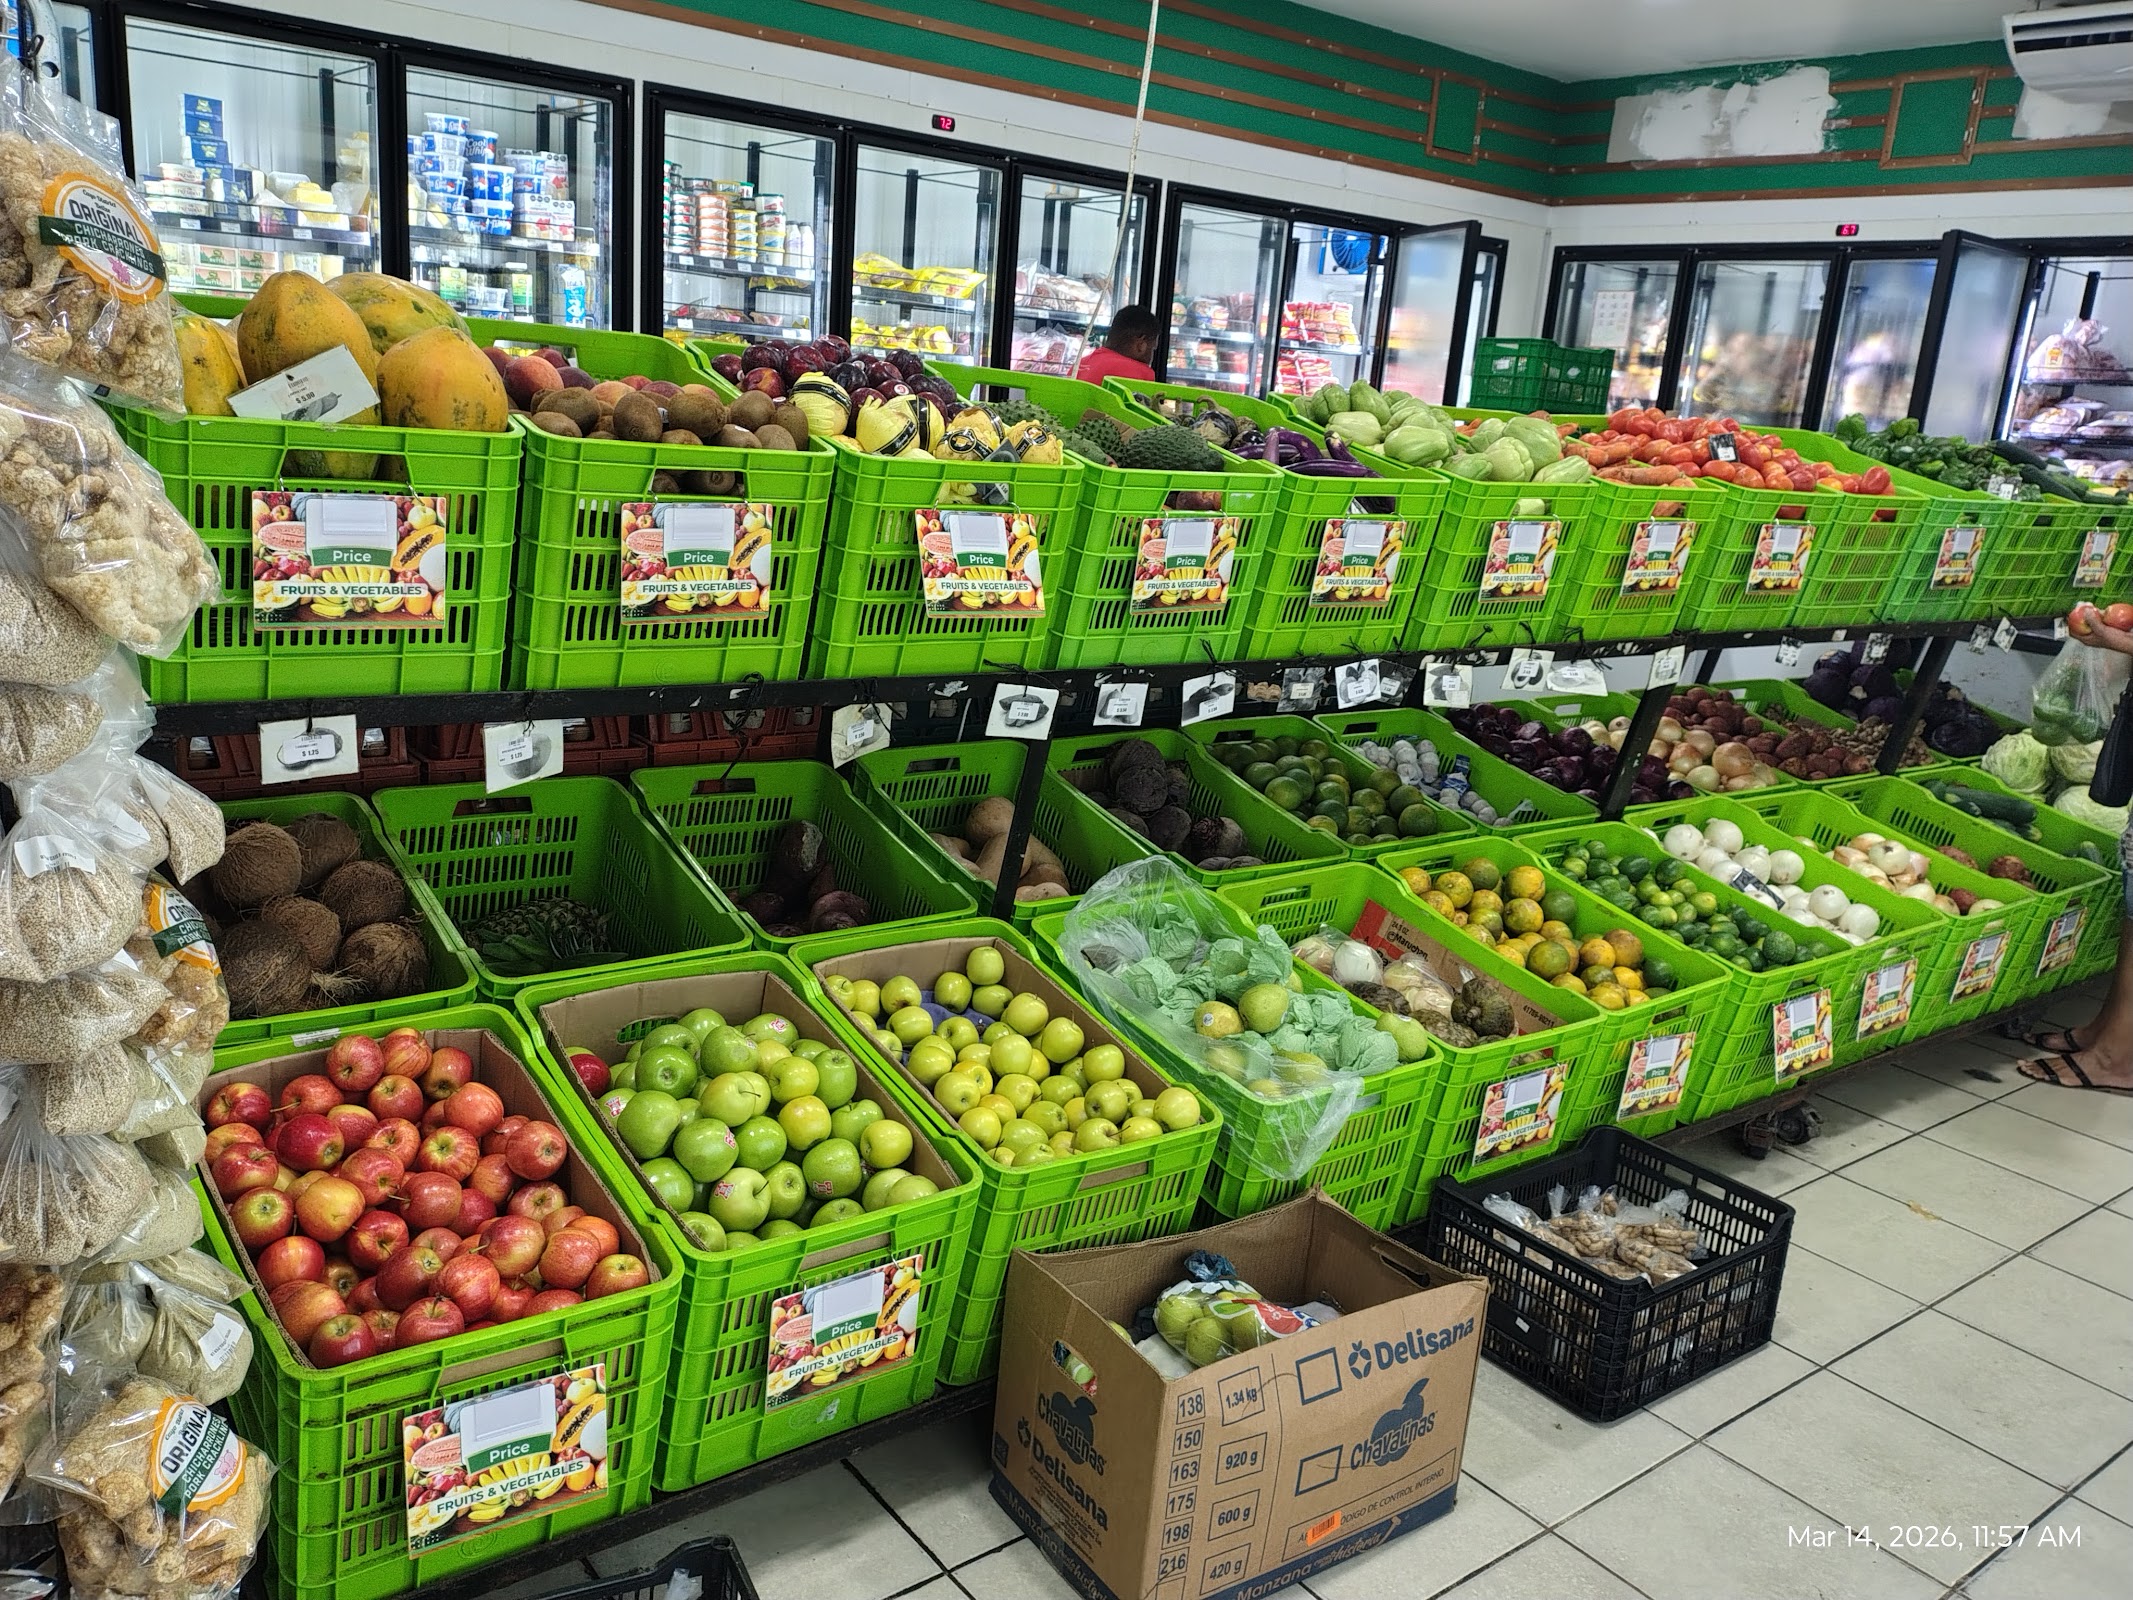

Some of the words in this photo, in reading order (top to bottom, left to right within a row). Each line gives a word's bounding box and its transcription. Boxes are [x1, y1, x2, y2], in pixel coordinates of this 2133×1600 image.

[68, 199, 144, 246] ORIGINAL
[74, 223, 145, 258] CHICHARRONES
[332, 550, 372, 562] Price
[684, 552, 714, 563] Price
[970, 554, 994, 564] Price
[1176, 558, 1196, 566] Price
[1351, 556, 1368, 564] Price
[1515, 554, 1529, 562] Price
[1653, 552, 1666, 560] Price
[280, 586, 326, 595] FRUITS
[330, 586, 340, 594] &
[342, 586, 422, 595] VEGETABLES
[642, 584, 677, 593] FRUITS
[682, 584, 687, 592] &
[690, 582, 752, 592] VEGETABLES
[941, 582, 969, 590] FRUITS
[972, 582, 976, 590] &
[978, 582, 1028, 590] VEGETABLES
[1178, 580, 1218, 588] VEGETABLES
[178, 930, 203, 947] PORK
[1513, 1107, 1530, 1117] Price
[1487, 1133, 1507, 1144] FRUITS
[1512, 1121, 1546, 1136] VEGETABLES
[831, 1321, 862, 1337] Price
[1374, 1316, 1474, 1370] Delisana
[788, 1360, 824, 1378] FRUITS
[827, 1356, 833, 1365] &
[836, 1335, 899, 1362] VEGETABLES
[1179, 1394, 1204, 1417] 138
[1226, 1390, 1244, 1409] 1.34
[1246, 1388, 1257, 1402] kg
[161, 1406, 207, 1474] ORIGINAL
[182, 1417, 221, 1483] CHICHARRONES
[1176, 1430, 1201, 1450] 150
[489, 1443, 530, 1462] Price
[1225, 1451, 1247, 1470] 920
[1250, 1451, 1257, 1466] g
[1173, 1461, 1198, 1481] 163
[185, 1471, 206, 1499] PORK
[436, 1491, 484, 1514] FRUITS
[487, 1488, 497, 1497] &
[500, 1460, 584, 1493] VEGETABLES
[1033, 1435, 1108, 1531] Delisana
[1367, 1503, 1378, 1513] DE
[1380, 1486, 1413, 1508] CONTROL
[1415, 1467, 1445, 1491] INTERNO
[1169, 1492, 1194, 1513] 175
[1218, 1508, 1240, 1526] 600
[1243, 1507, 1250, 1521] g
[1165, 1524, 1190, 1544] 198
[1160, 1553, 1186, 1575] 216
[1210, 1561, 1231, 1580] 420
[1234, 1560, 1242, 1574] g
[1236, 1562, 1312, 1600] Manzana
